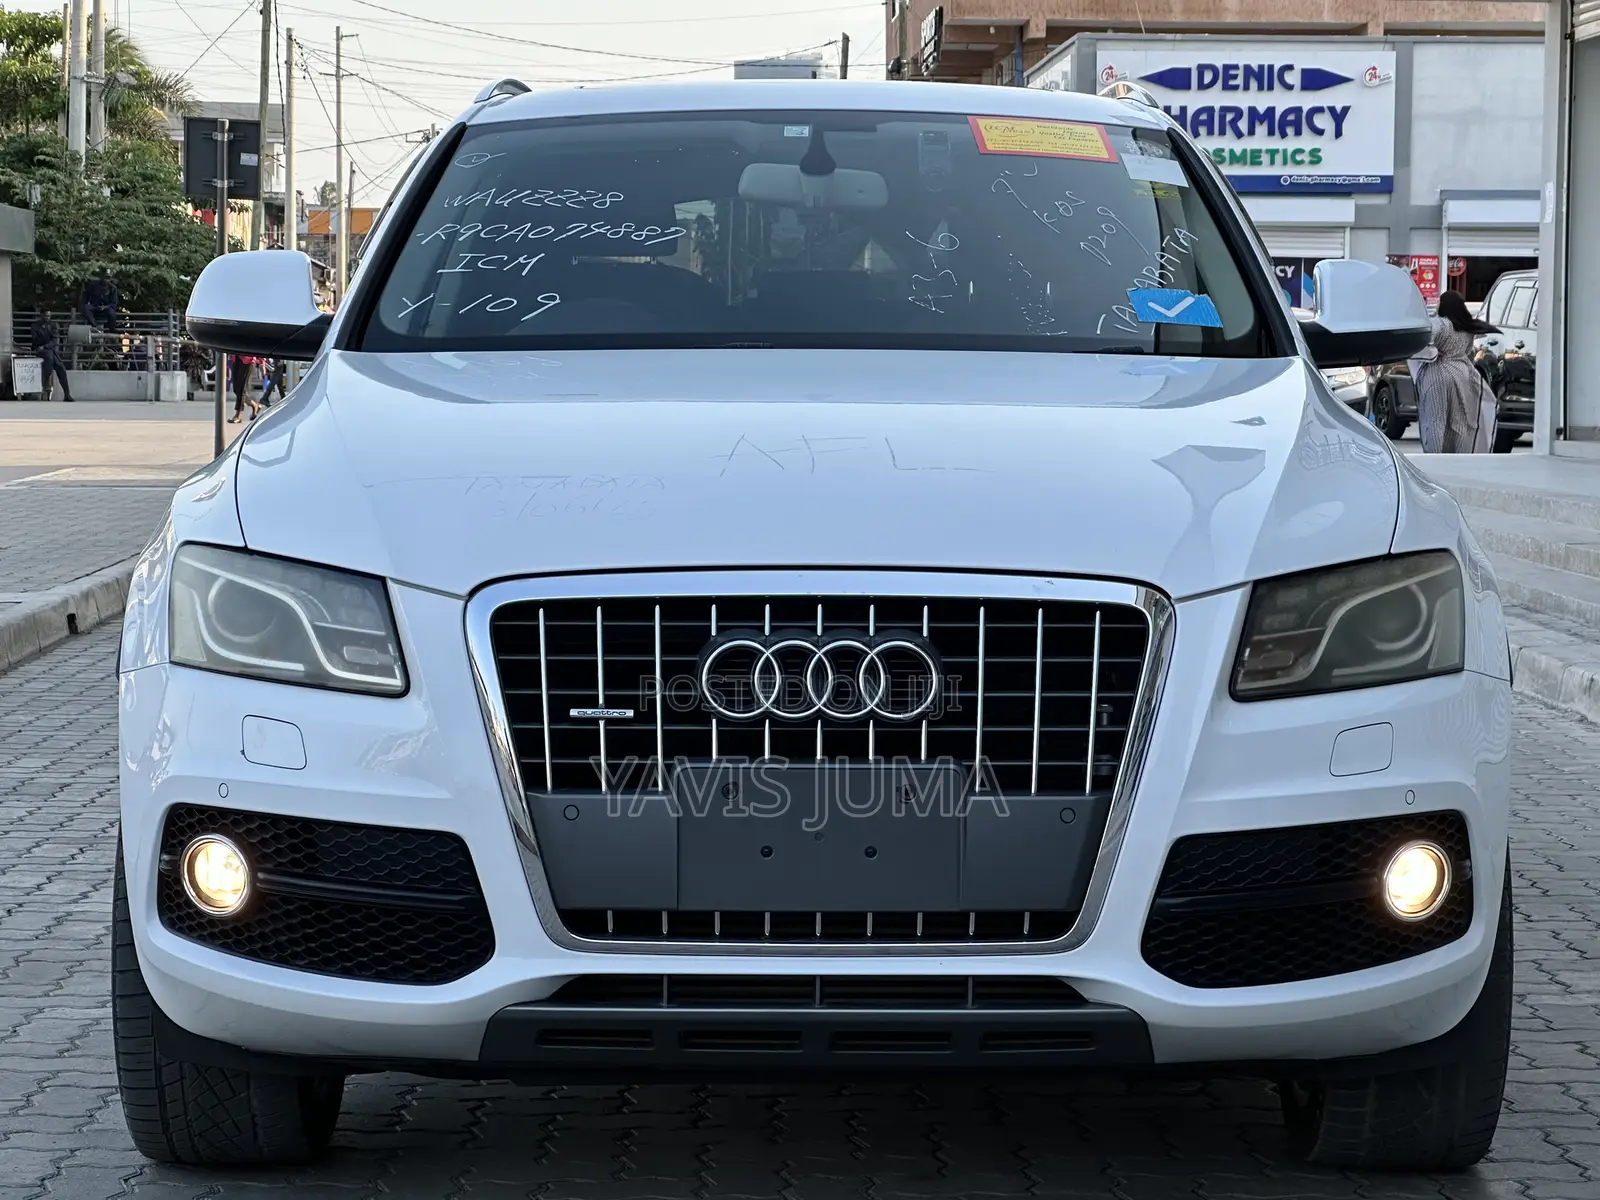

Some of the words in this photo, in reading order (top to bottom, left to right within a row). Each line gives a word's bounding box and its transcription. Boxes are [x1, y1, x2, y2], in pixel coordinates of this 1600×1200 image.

[1196, 63, 1296, 91] DENIC
[1163, 105, 1352, 140] HARMACY
[1203, 147, 1323, 166] SMETICS
